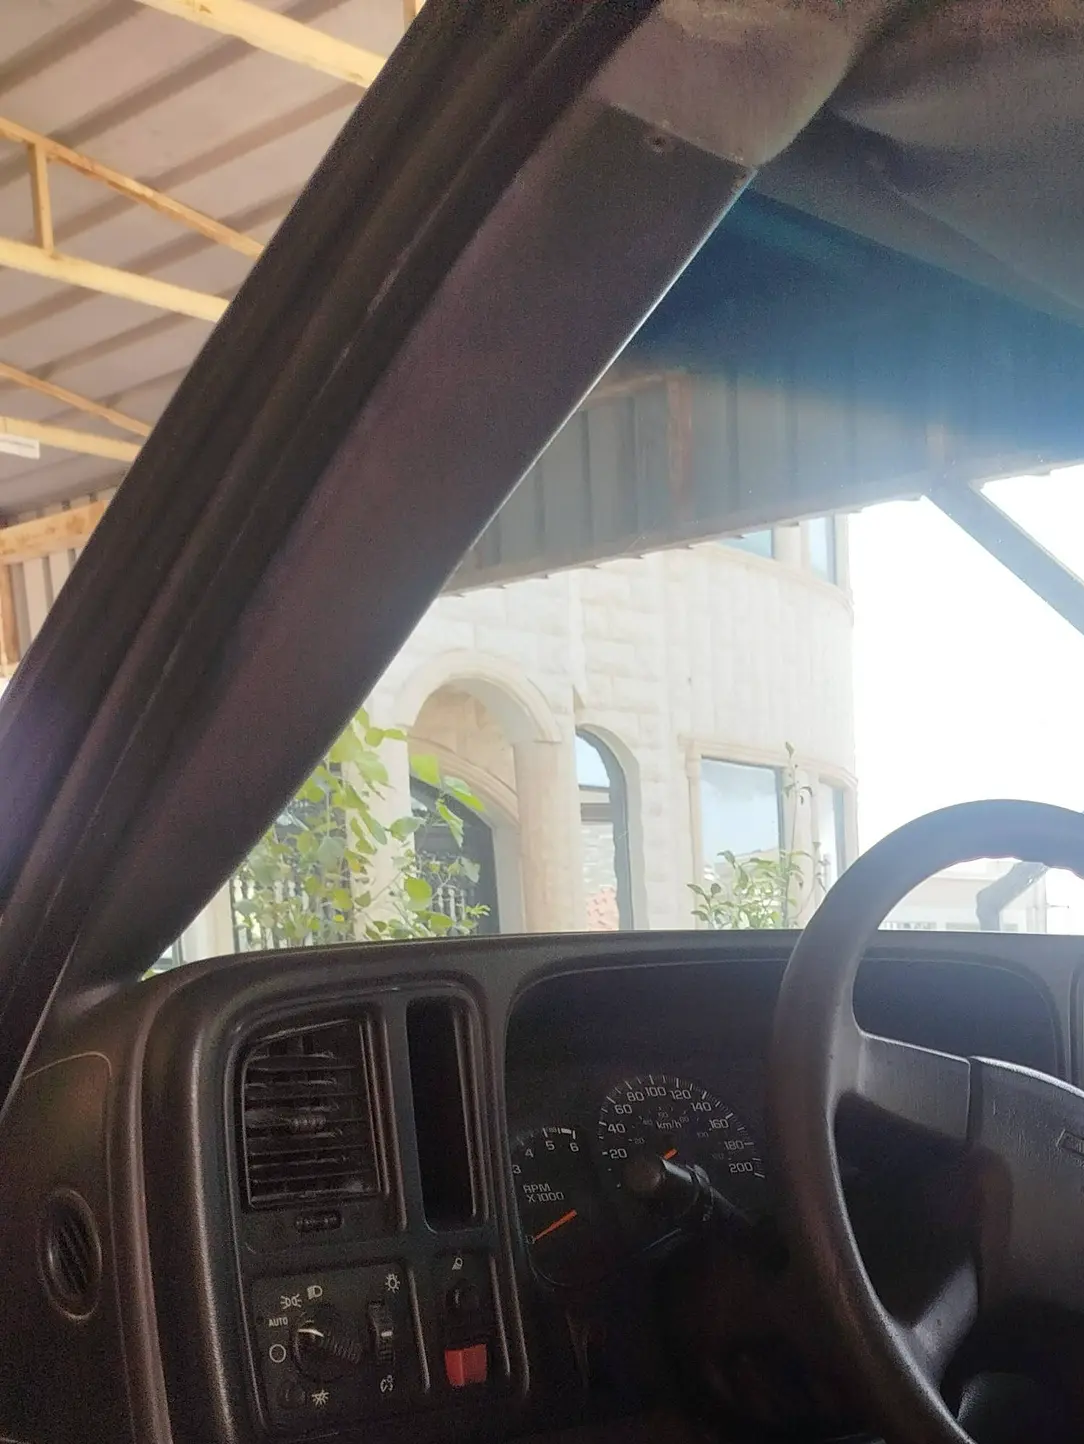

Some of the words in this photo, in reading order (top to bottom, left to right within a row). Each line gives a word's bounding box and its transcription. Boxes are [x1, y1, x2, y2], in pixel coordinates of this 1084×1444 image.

[626, 1091, 645, 1101] 80
[645, 1086, 666, 1097] 100
[670, 1089, 691, 1100] 120
[614, 1104, 633, 1114] 60
[690, 1102, 712, 1112] 140
[608, 1123, 626, 1133] 40
[656, 1120, 682, 1130] km/h
[709, 1119, 729, 1129] 160
[545, 1140, 555, 1151] 5
[570, 1142, 579, 1152] 6
[724, 1140, 744, 1150] 180
[525, 1148, 534, 1158] 4
[609, 1148, 627, 1159] 20
[512, 1164, 522, 1174] 3
[728, 1162, 753, 1173] 200
[523, 1183, 552, 1194] RPM
[269, 1317, 288, 1328] AUTO
